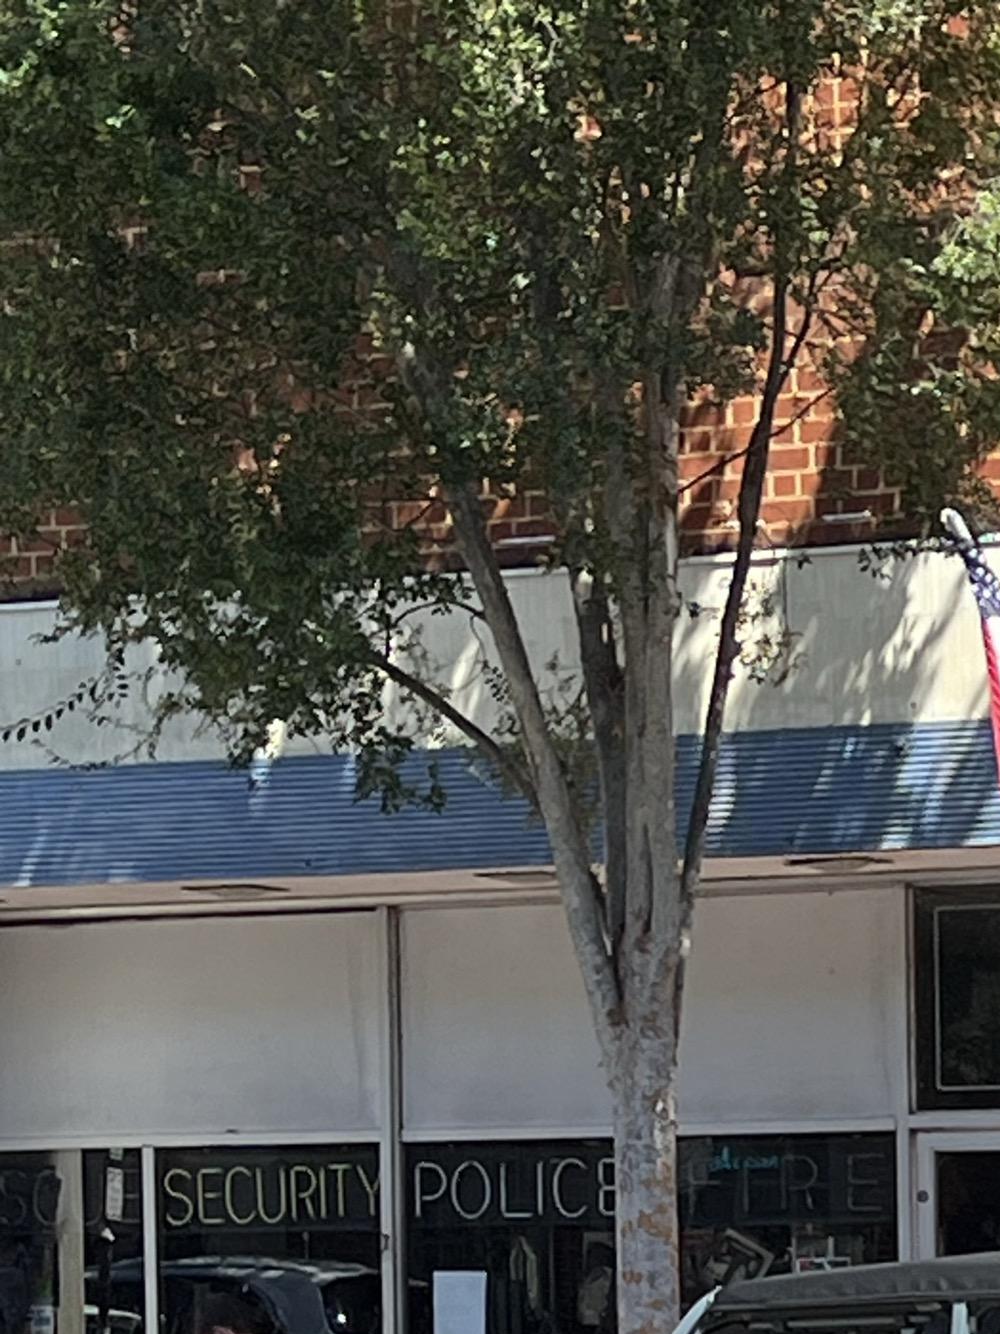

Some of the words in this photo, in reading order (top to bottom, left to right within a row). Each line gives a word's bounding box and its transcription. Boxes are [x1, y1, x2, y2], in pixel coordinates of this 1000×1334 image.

[164, 1164, 380, 1226] SECURITY
[415, 1158, 615, 1219] POLICE
[688, 1153, 885, 1217] FIRE
